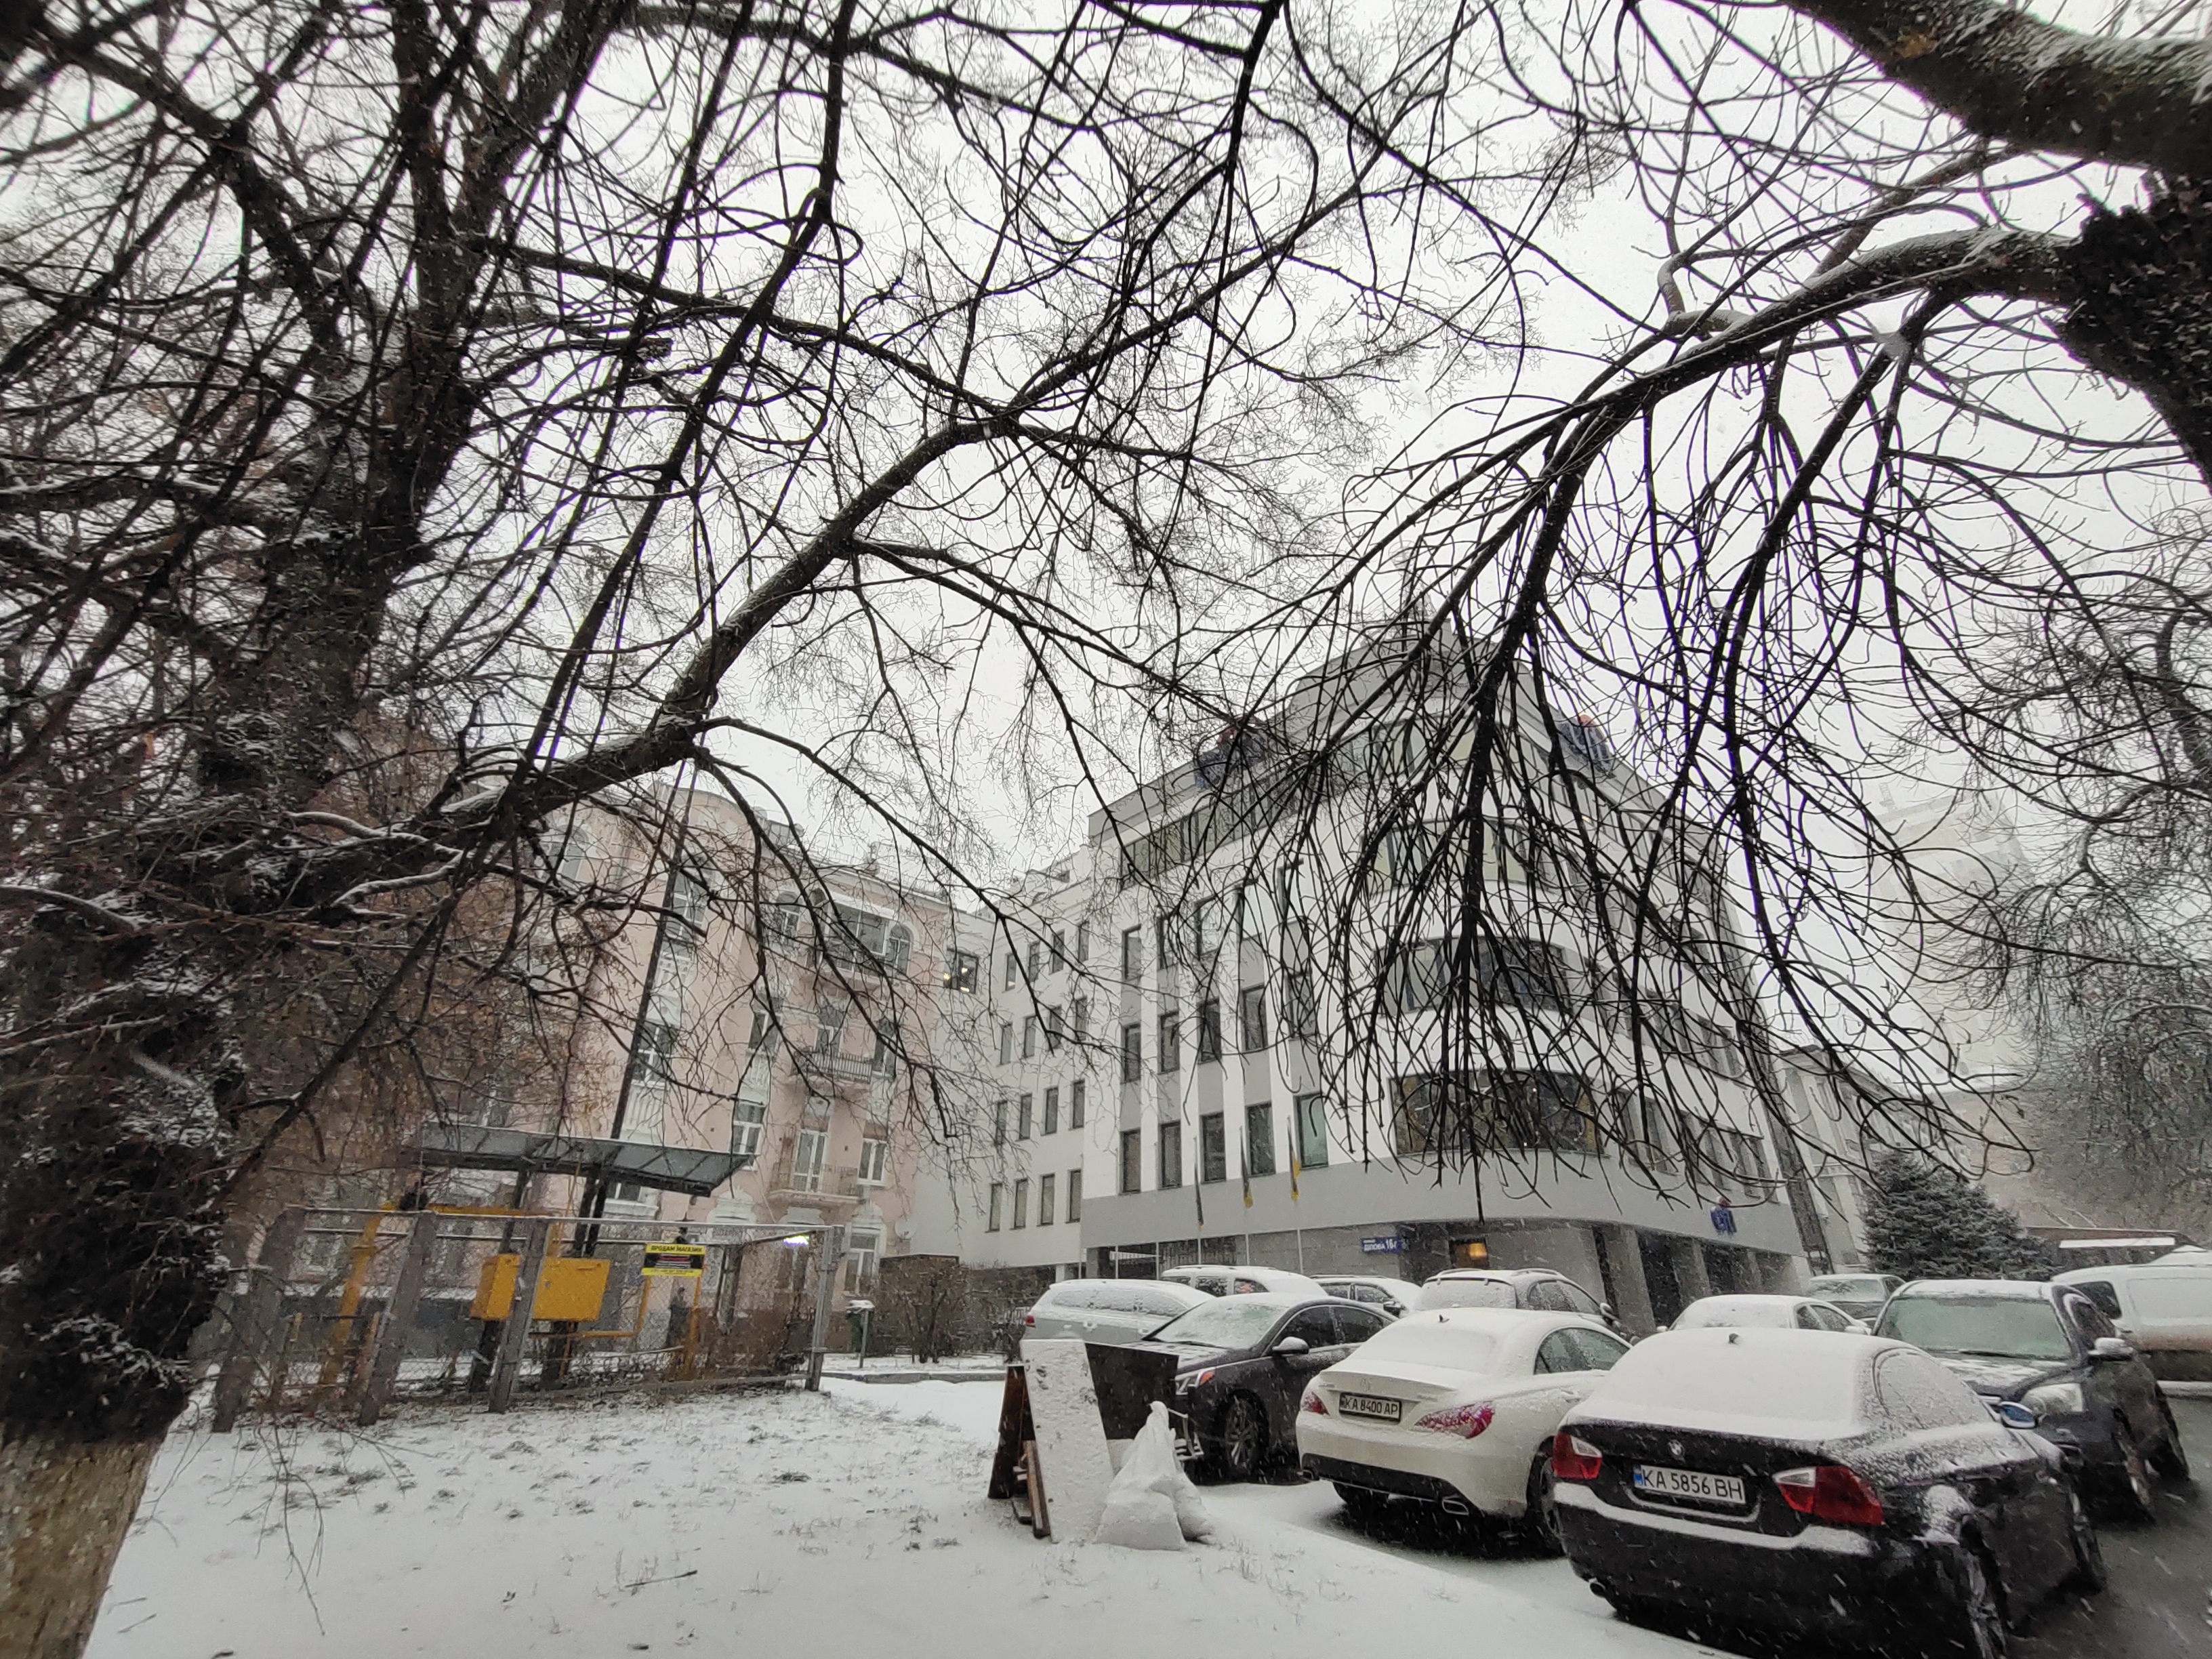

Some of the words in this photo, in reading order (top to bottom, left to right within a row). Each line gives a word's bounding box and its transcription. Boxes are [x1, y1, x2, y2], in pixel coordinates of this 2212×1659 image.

[1345, 1397, 1358, 1410] KA
[1360, 1399, 1382, 1414] 8400
[1384, 1403, 1398, 1415] AP
[1642, 1469, 1666, 1489] KA
[1671, 1472, 1711, 1494] 5856
[1715, 1478, 1742, 1500] BH
